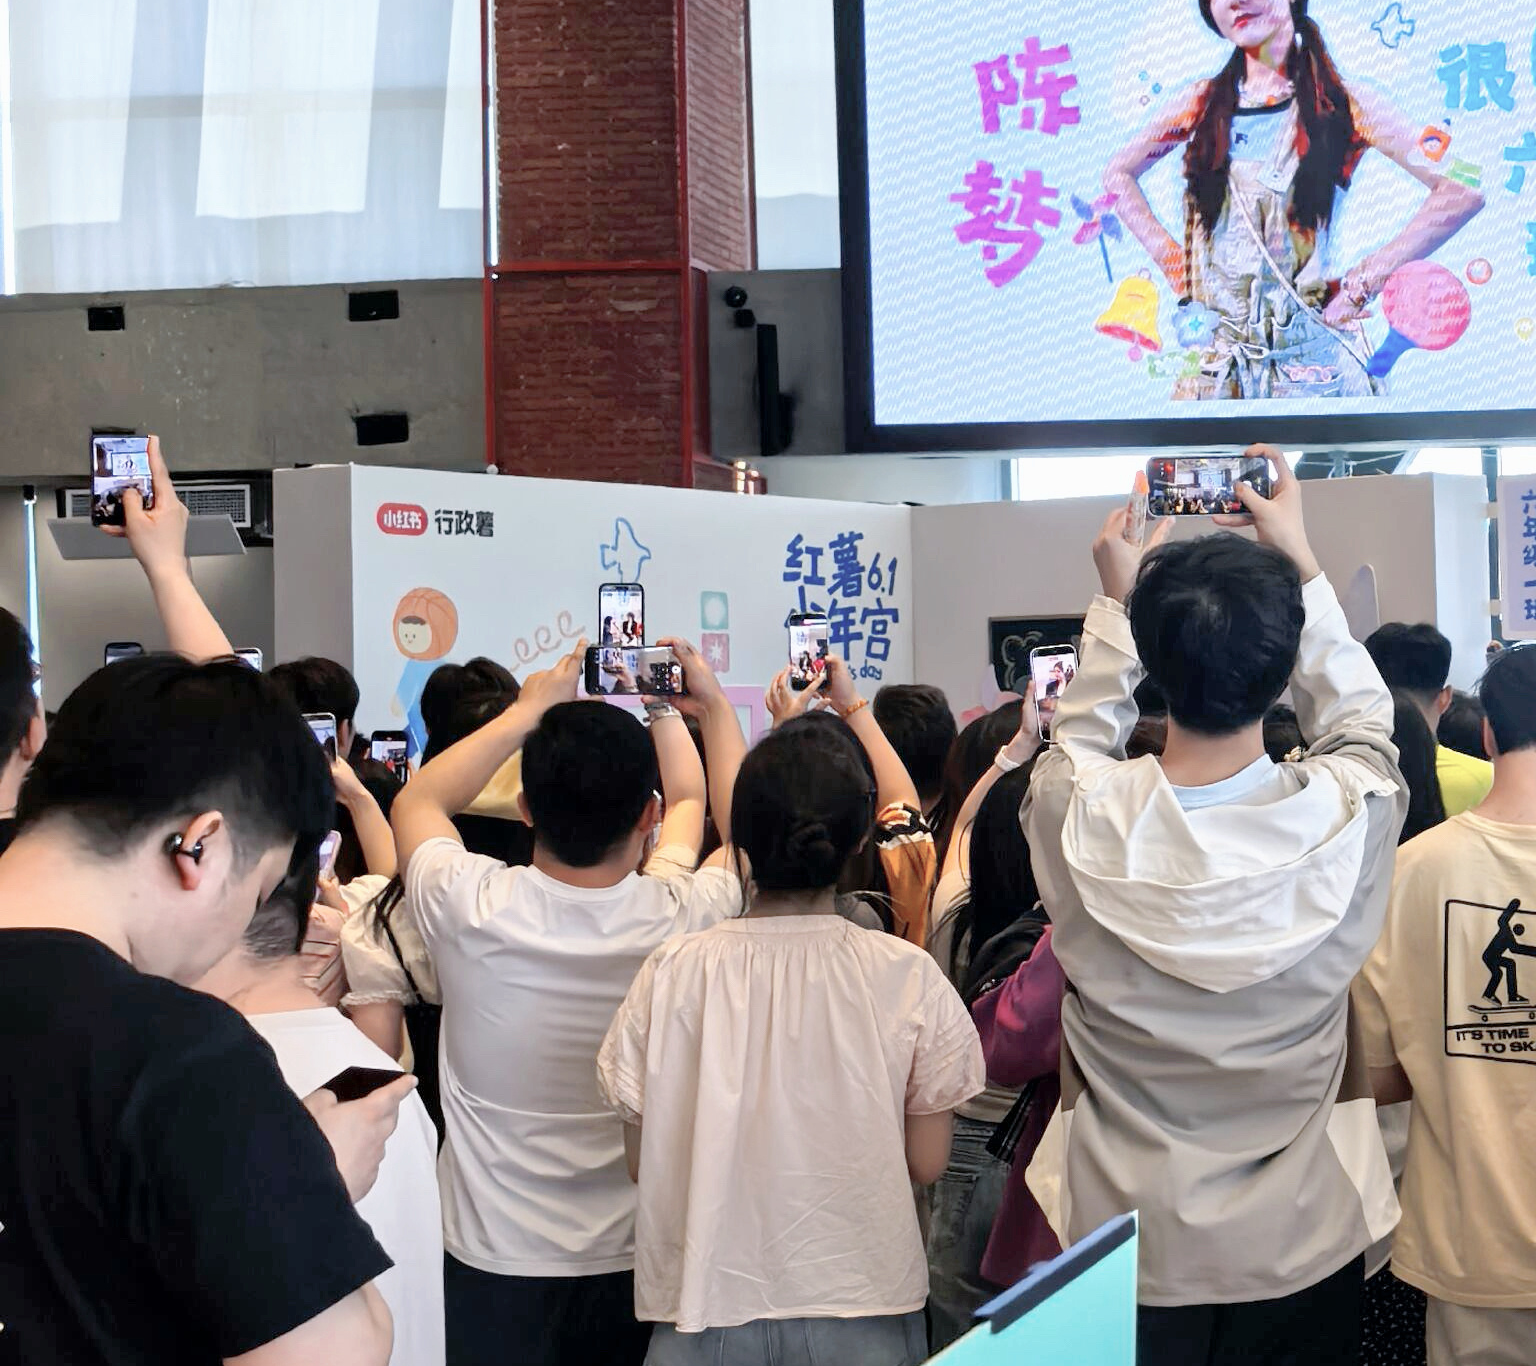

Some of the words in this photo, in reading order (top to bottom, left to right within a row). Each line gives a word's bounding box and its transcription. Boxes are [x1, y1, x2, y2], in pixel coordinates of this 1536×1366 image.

[384, 510, 422, 530] 小红书
[435, 510, 494, 537] 行政薯
[860, 659, 883, 681] day
[1487, 1028, 1530, 1040] TIME
[1481, 1042, 1506, 1054] TO
